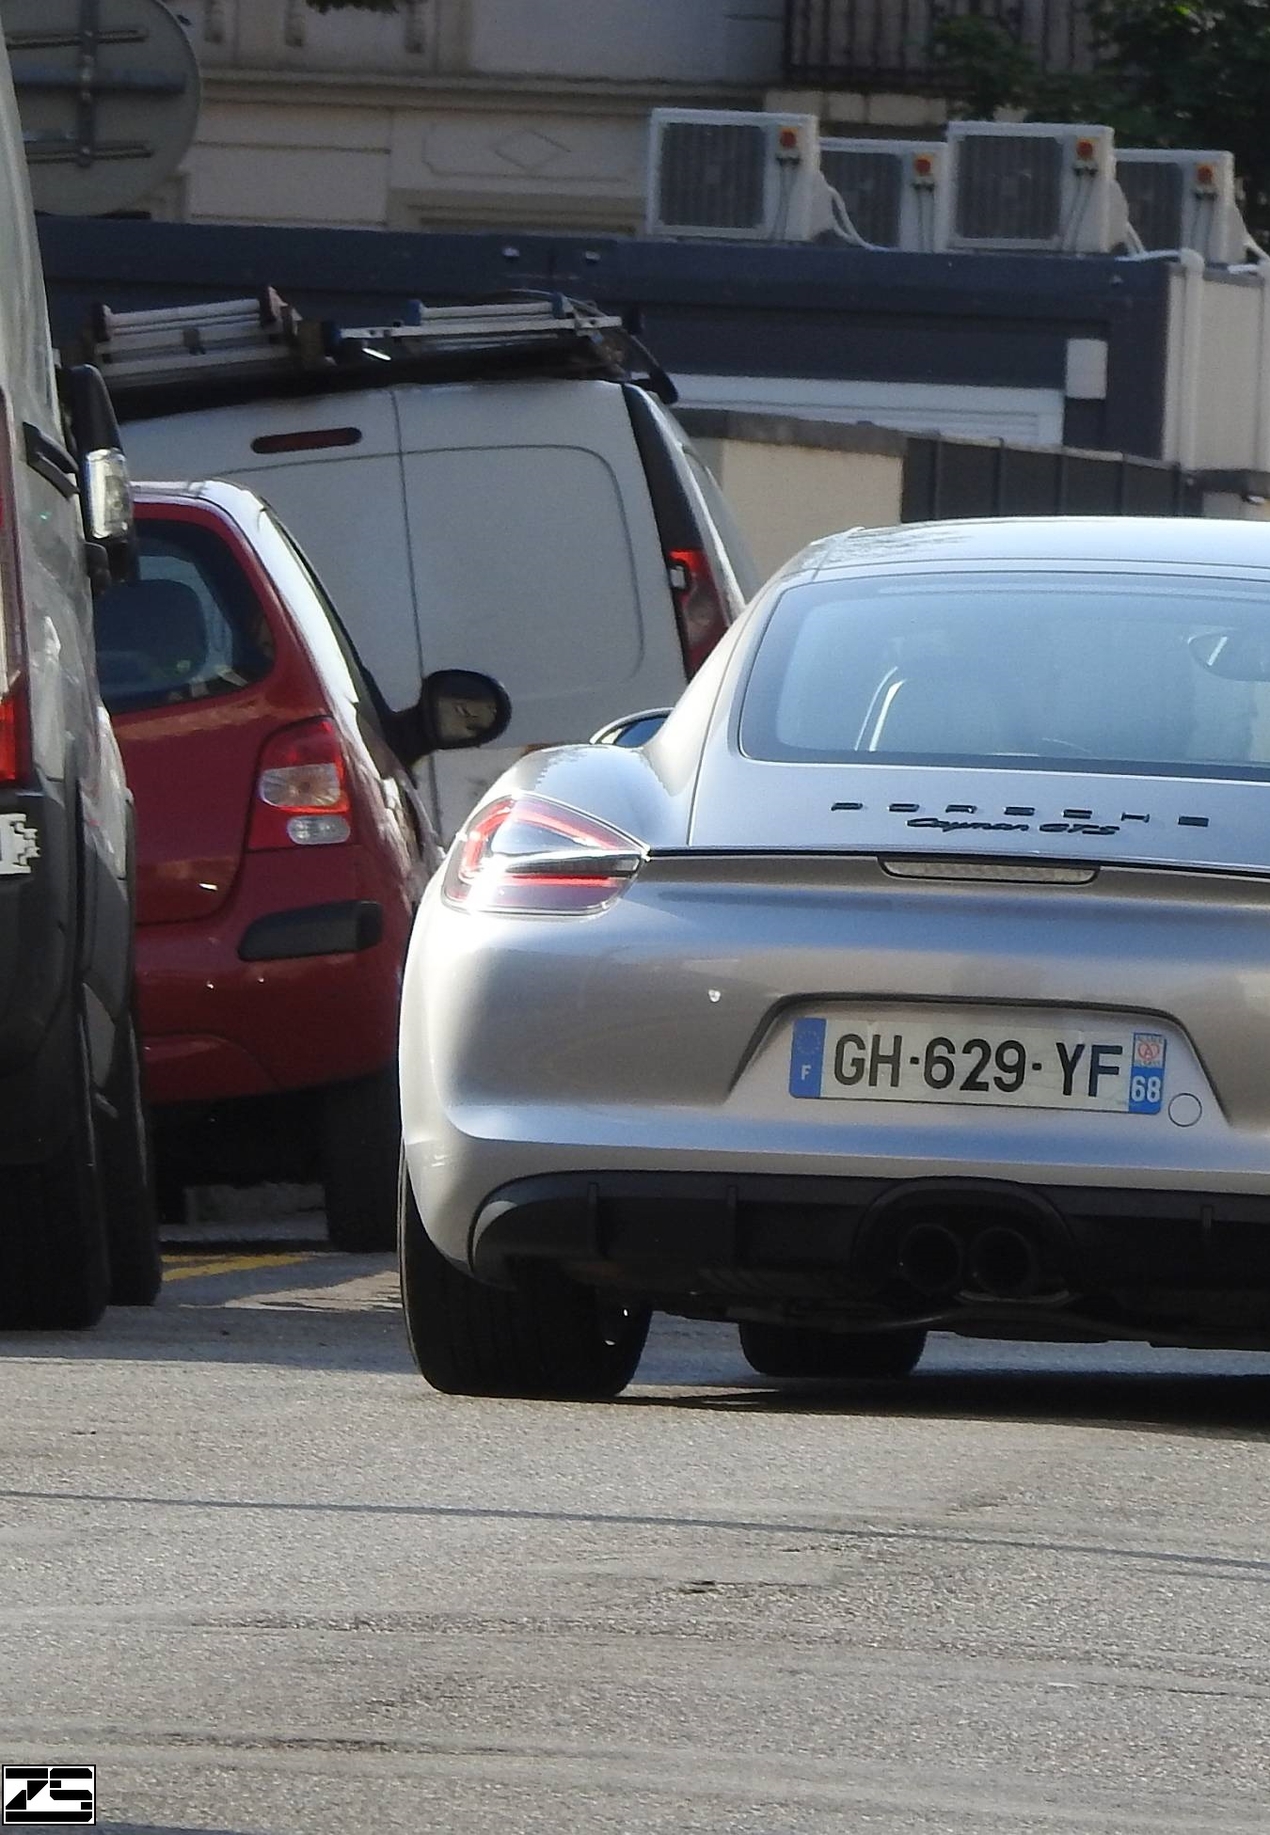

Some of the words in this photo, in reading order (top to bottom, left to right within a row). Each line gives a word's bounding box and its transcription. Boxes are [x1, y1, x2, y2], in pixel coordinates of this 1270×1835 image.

[831, 801, 1210, 827] PORSCHE
[906, 817, 1030, 833] Cayman
[1039, 823, 1120, 836] GTS
[800, 1064, 812, 1081] F
[833, 1032, 1124, 1098] GH-629-YF
[1130, 1075, 1162, 1103] 68
